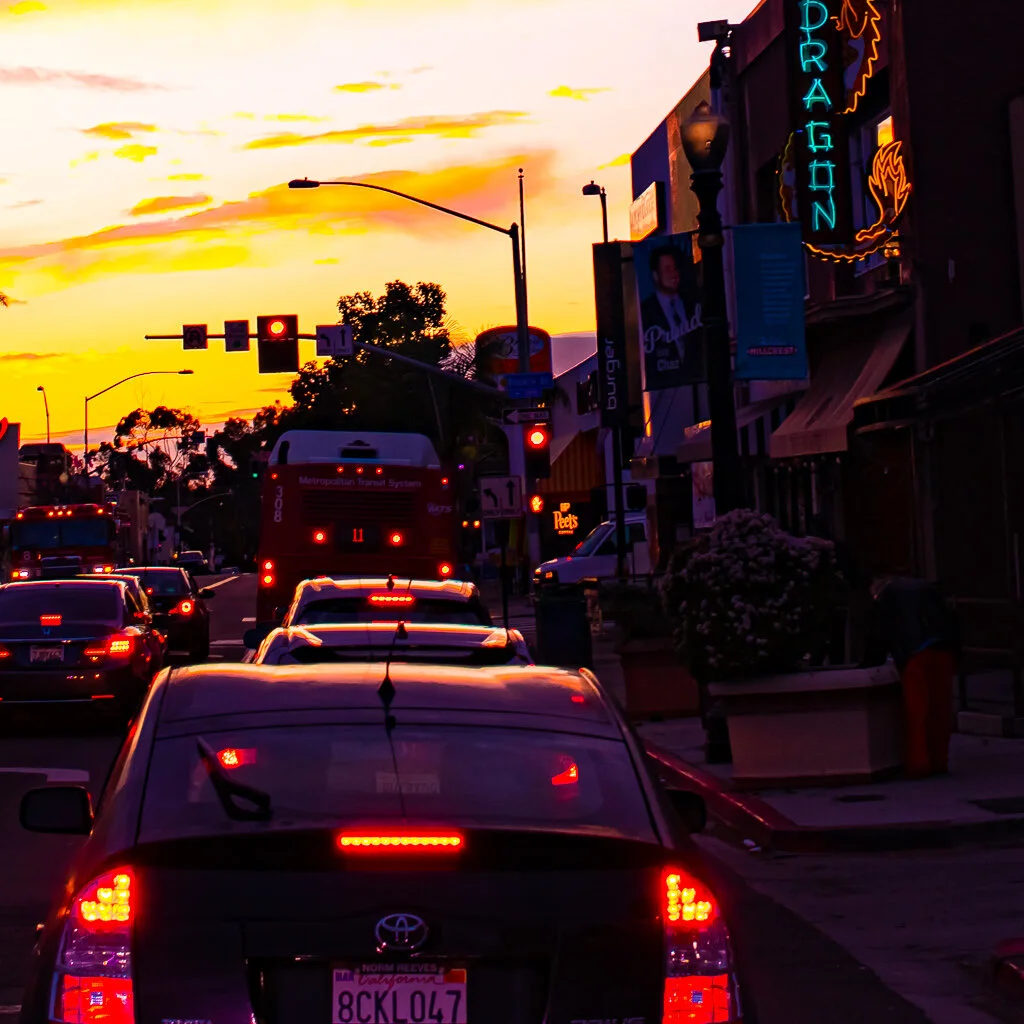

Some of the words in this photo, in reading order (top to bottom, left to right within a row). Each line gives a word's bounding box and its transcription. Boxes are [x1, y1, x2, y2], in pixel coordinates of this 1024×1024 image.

[604, 337, 621, 411] burger
[388, 479, 422, 489] System
[274, 485, 283, 522] 308
[352, 528, 365, 543] 11
[358, 974, 444, 990] California
[338, 990, 462, 1024] 8CKL047
